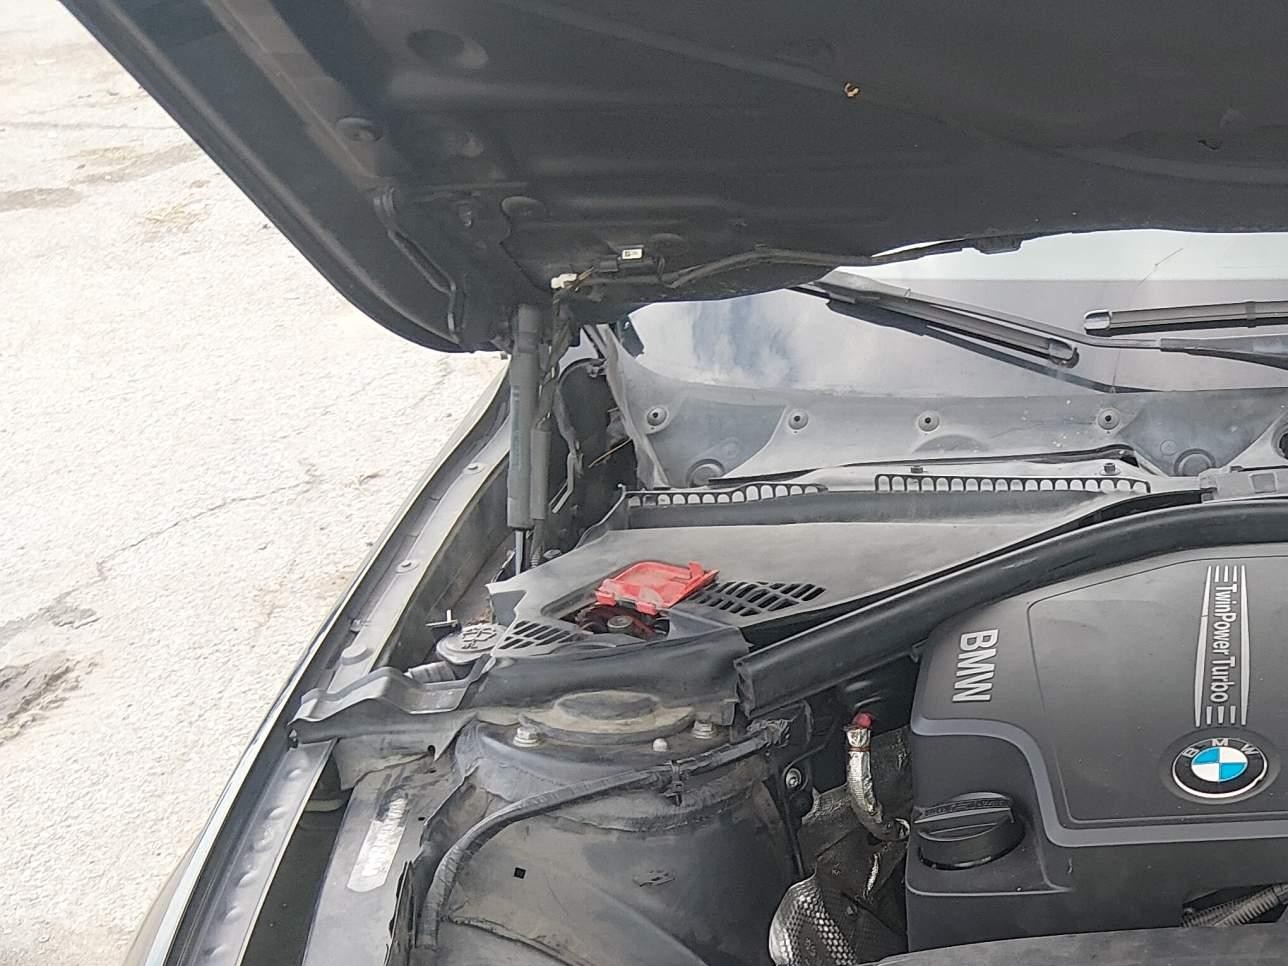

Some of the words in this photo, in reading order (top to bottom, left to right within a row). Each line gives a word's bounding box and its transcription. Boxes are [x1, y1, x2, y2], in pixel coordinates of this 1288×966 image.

[1212, 583, 1238, 655] TwinPower
[952, 629, 999, 702] BMW
[1210, 656, 1236, 703] Turbo
[1182, 737, 1260, 758] BMW
